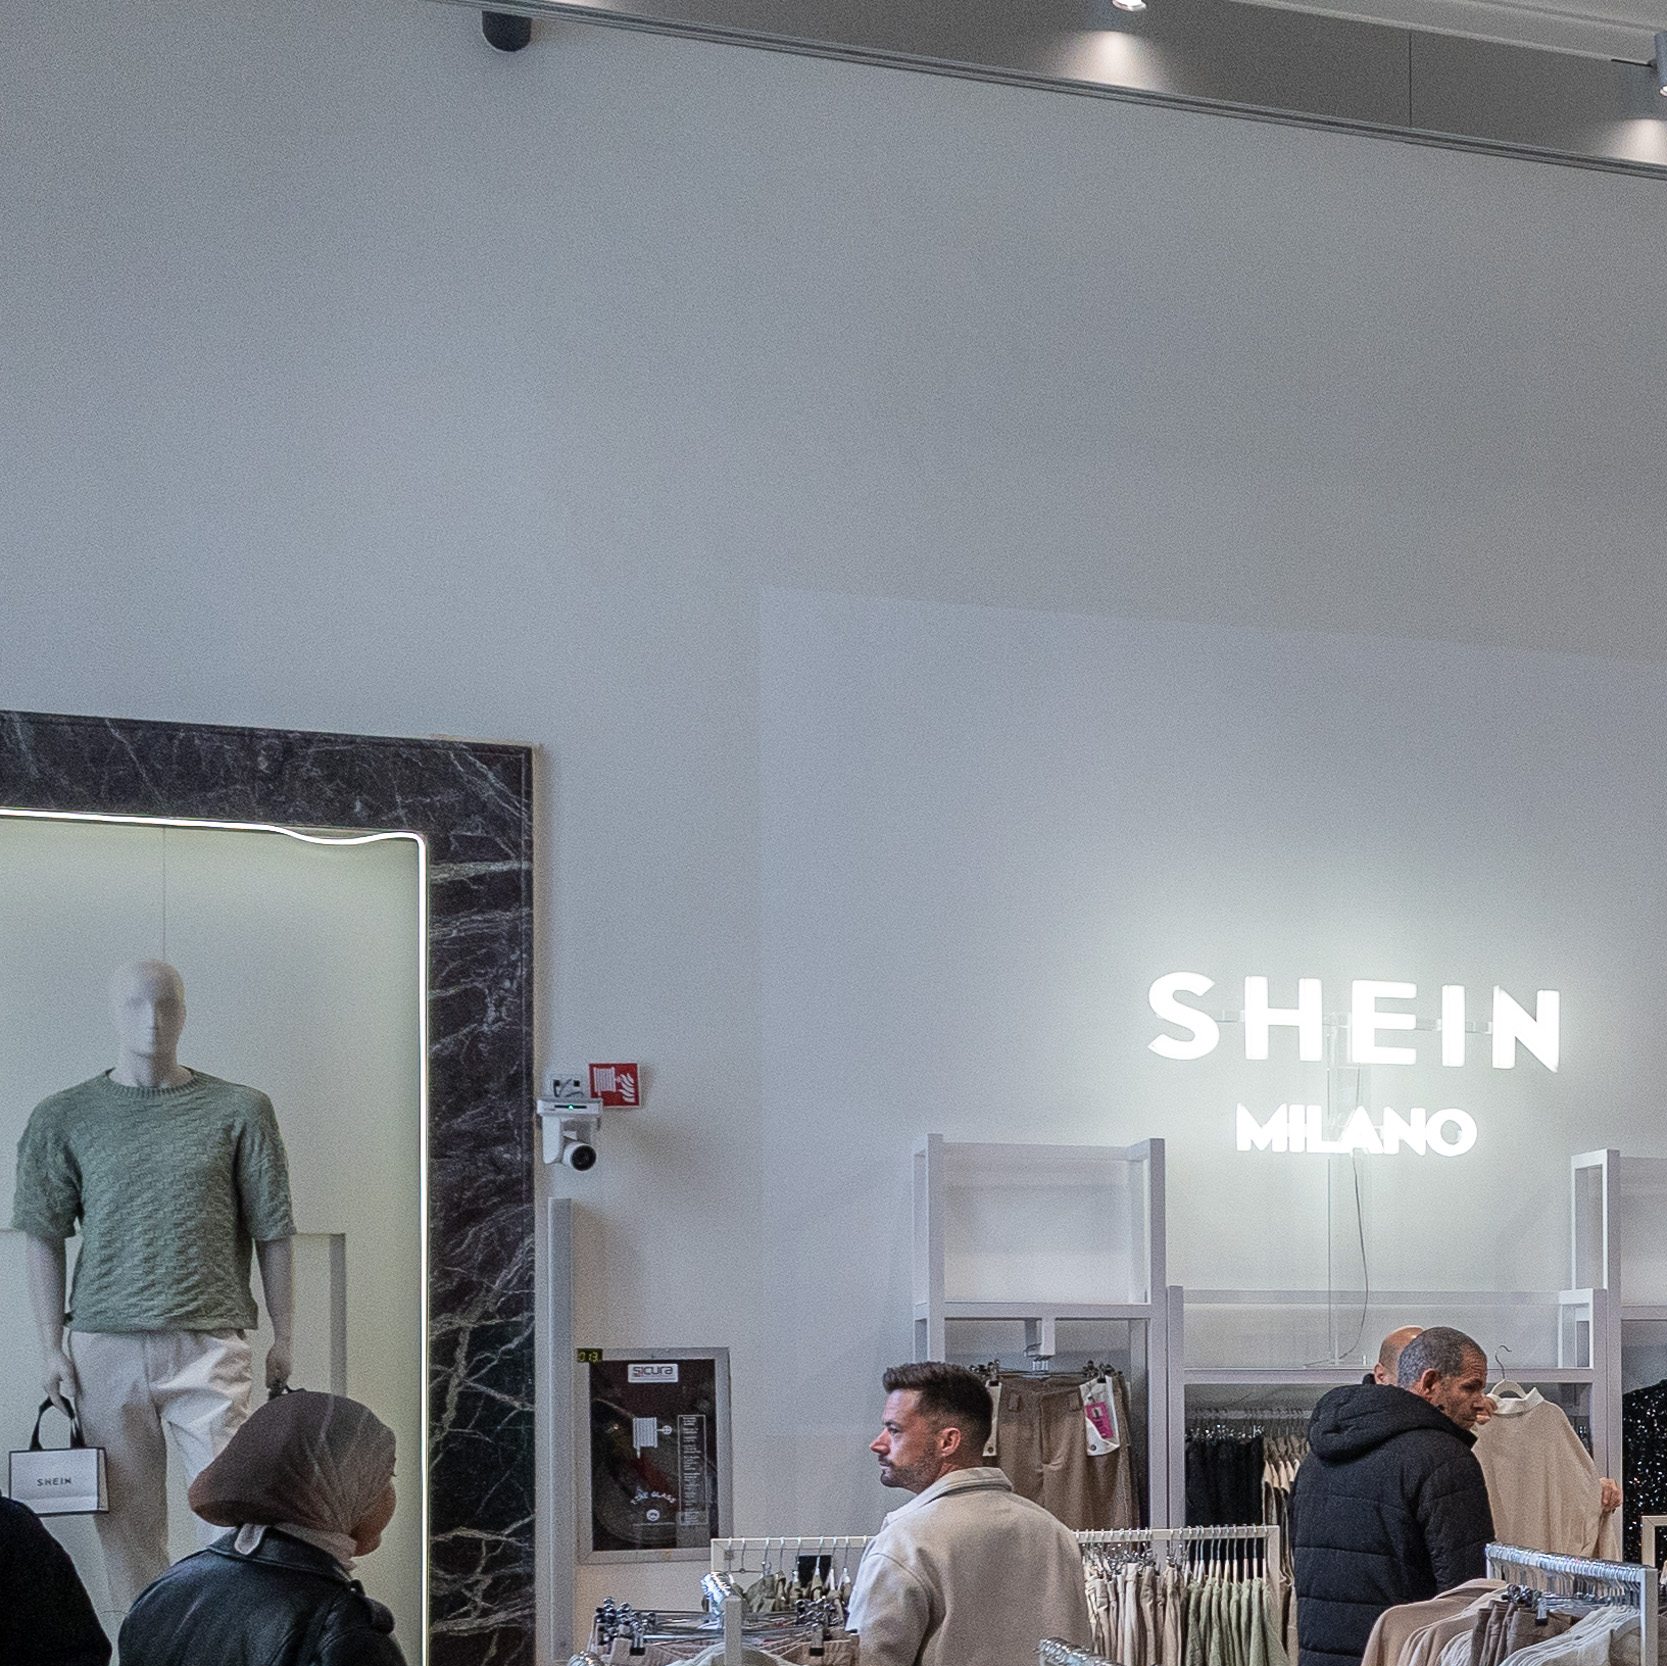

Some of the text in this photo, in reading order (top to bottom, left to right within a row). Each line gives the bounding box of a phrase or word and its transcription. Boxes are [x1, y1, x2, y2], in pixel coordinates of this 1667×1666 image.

[1147, 970, 1561, 1073] SHEIN
[1235, 1102, 1478, 1157] MILANO
[36, 1477, 72, 1487] SHEIN
